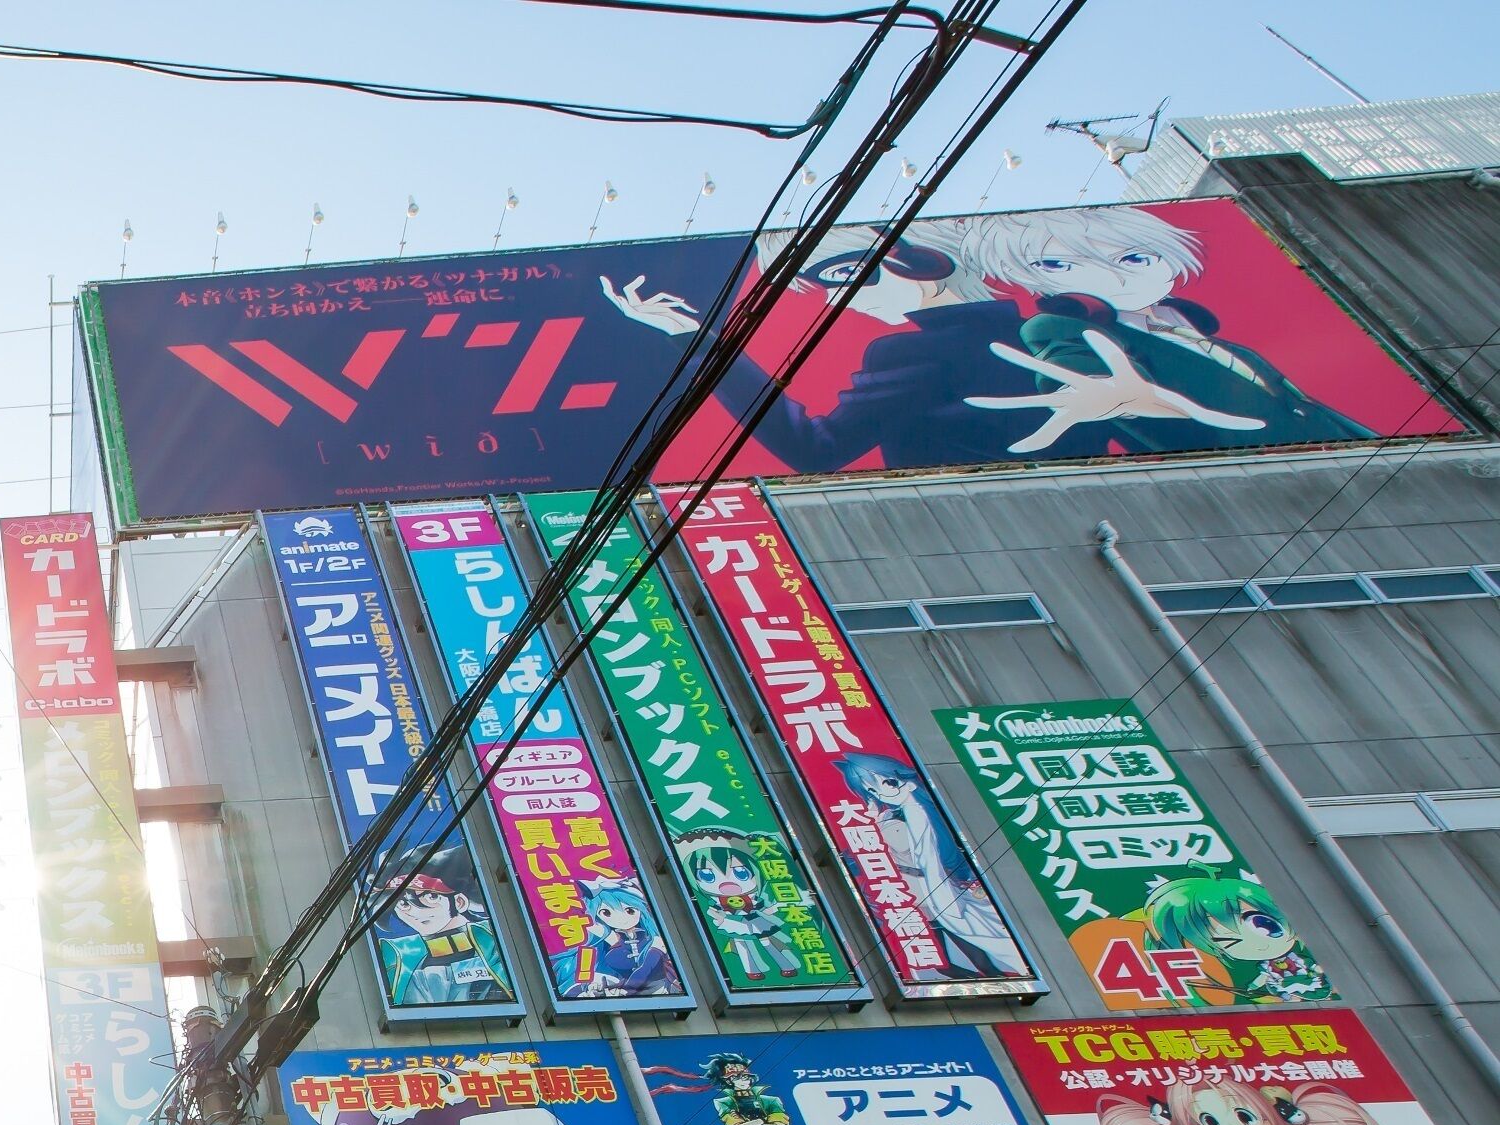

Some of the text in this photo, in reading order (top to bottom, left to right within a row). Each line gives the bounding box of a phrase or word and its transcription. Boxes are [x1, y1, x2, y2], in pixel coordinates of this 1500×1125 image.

[678, 495, 746, 524] 5F
[20, 531, 78, 546] CARD
[411, 515, 488, 543] 3F
[279, 541, 360, 555] animate
[283, 556, 367, 574] 1F/2F
[23, 548, 96, 687] カードラボ
[754, 532, 872, 710] カードゲーム販売・買取
[700, 535, 864, 755] カードラボ
[24, 695, 114, 711] C-labo
[295, 592, 400, 817] アニメイト
[576, 560, 731, 822] メロンブックス
[1003, 712, 1143, 739] Melonbooks
[502, 772, 582, 788] ブルーレイ
[1029, 750, 1160, 782] 同人誌
[526, 796, 577, 811] 同人誌
[955, 711, 1111, 922] メロンブックス
[1052, 790, 1192, 820] 同人音楽
[43, 720, 114, 931] メロンブックス
[567, 817, 618, 879] 高く
[1081, 832, 1213, 861] コミック
[830, 798, 944, 969] 大阪日本橋店
[748, 836, 836, 975] 大阪日本橋店
[1094, 936, 1210, 1003] 4F
[75, 971, 134, 1001] 3F
[1029, 1024, 1135, 1036] トレーディングカードゲーム
[291, 1065, 617, 1114] 中古買取・中古販売
[1059, 1058, 1366, 1091] 公認・オリジナル大会開催
[824, 1083, 974, 1122] アニメ
